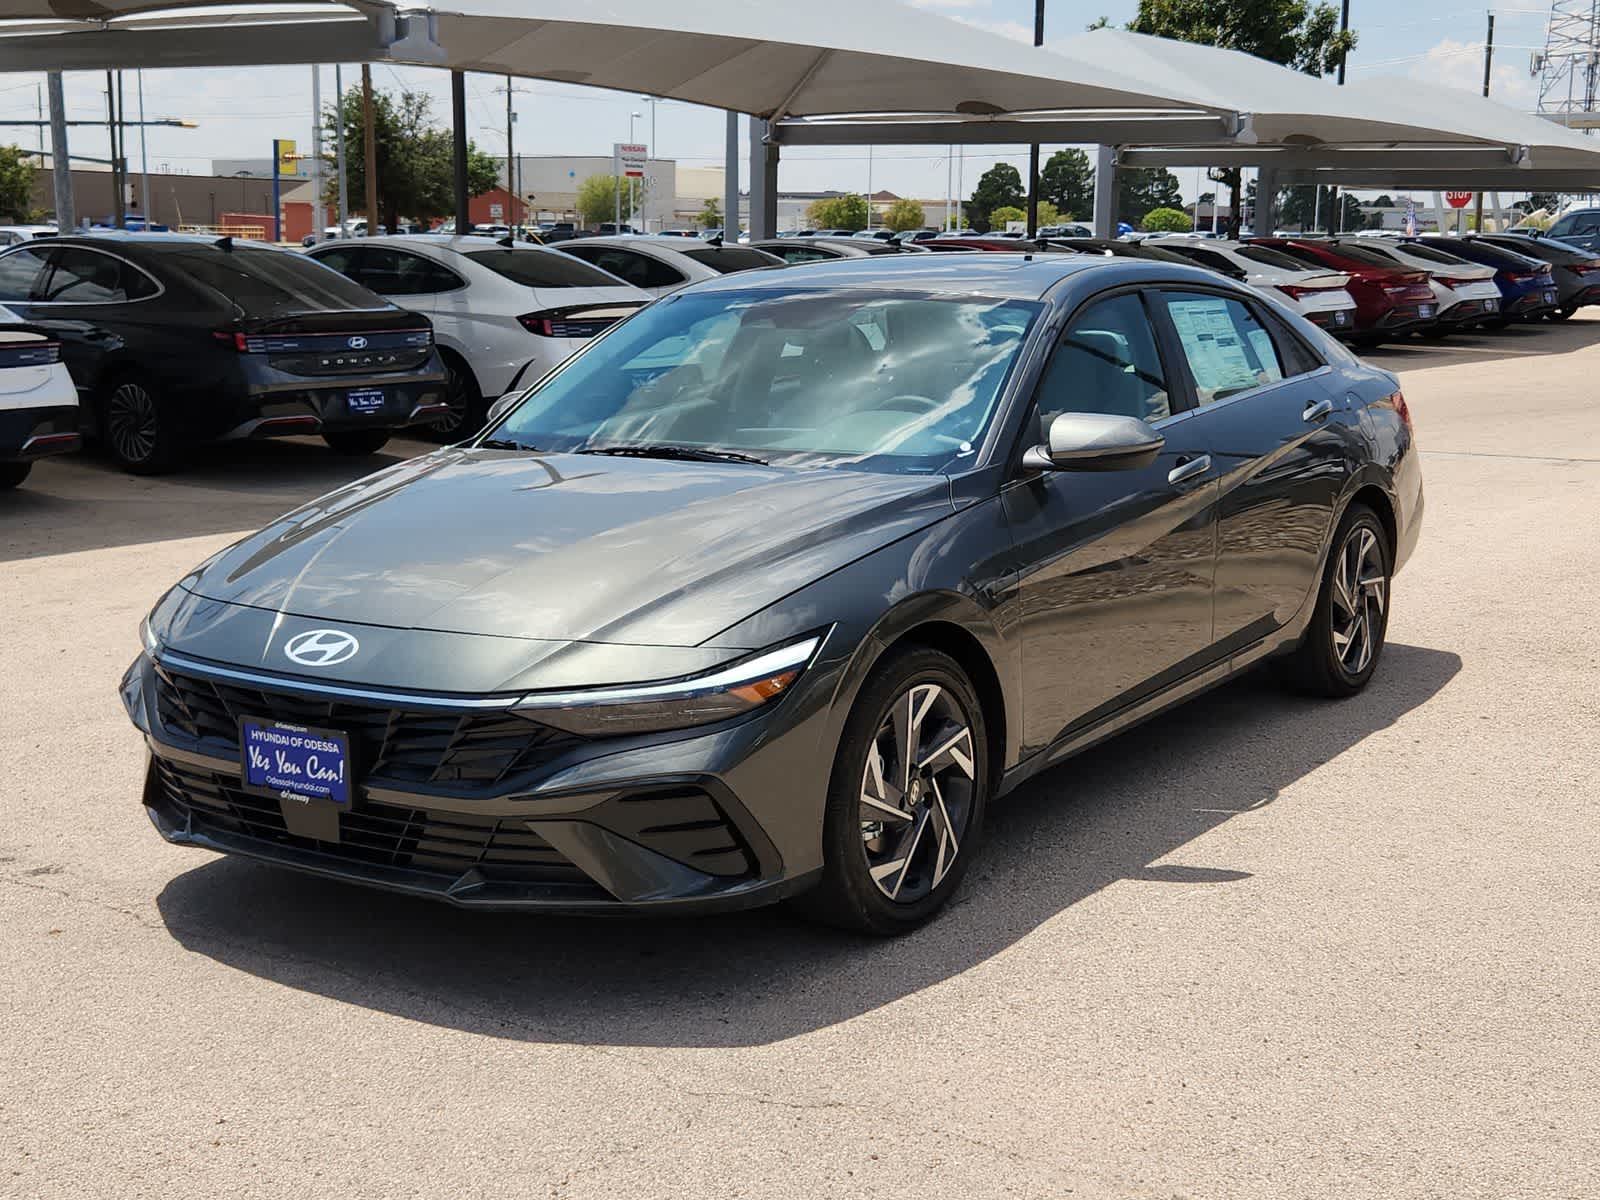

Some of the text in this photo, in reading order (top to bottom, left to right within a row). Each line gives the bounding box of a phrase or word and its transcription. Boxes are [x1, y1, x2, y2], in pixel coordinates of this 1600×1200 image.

[1447, 191, 1470, 199] STOP
[321, 356, 396, 365] SONATA
[251, 730, 340, 754] HYUNDAI OF ODESSA
[248, 745, 344, 783] Yes You Can!
[265, 775, 330, 793] OdessaHyundai.com
[280, 790, 310, 804] driveway
